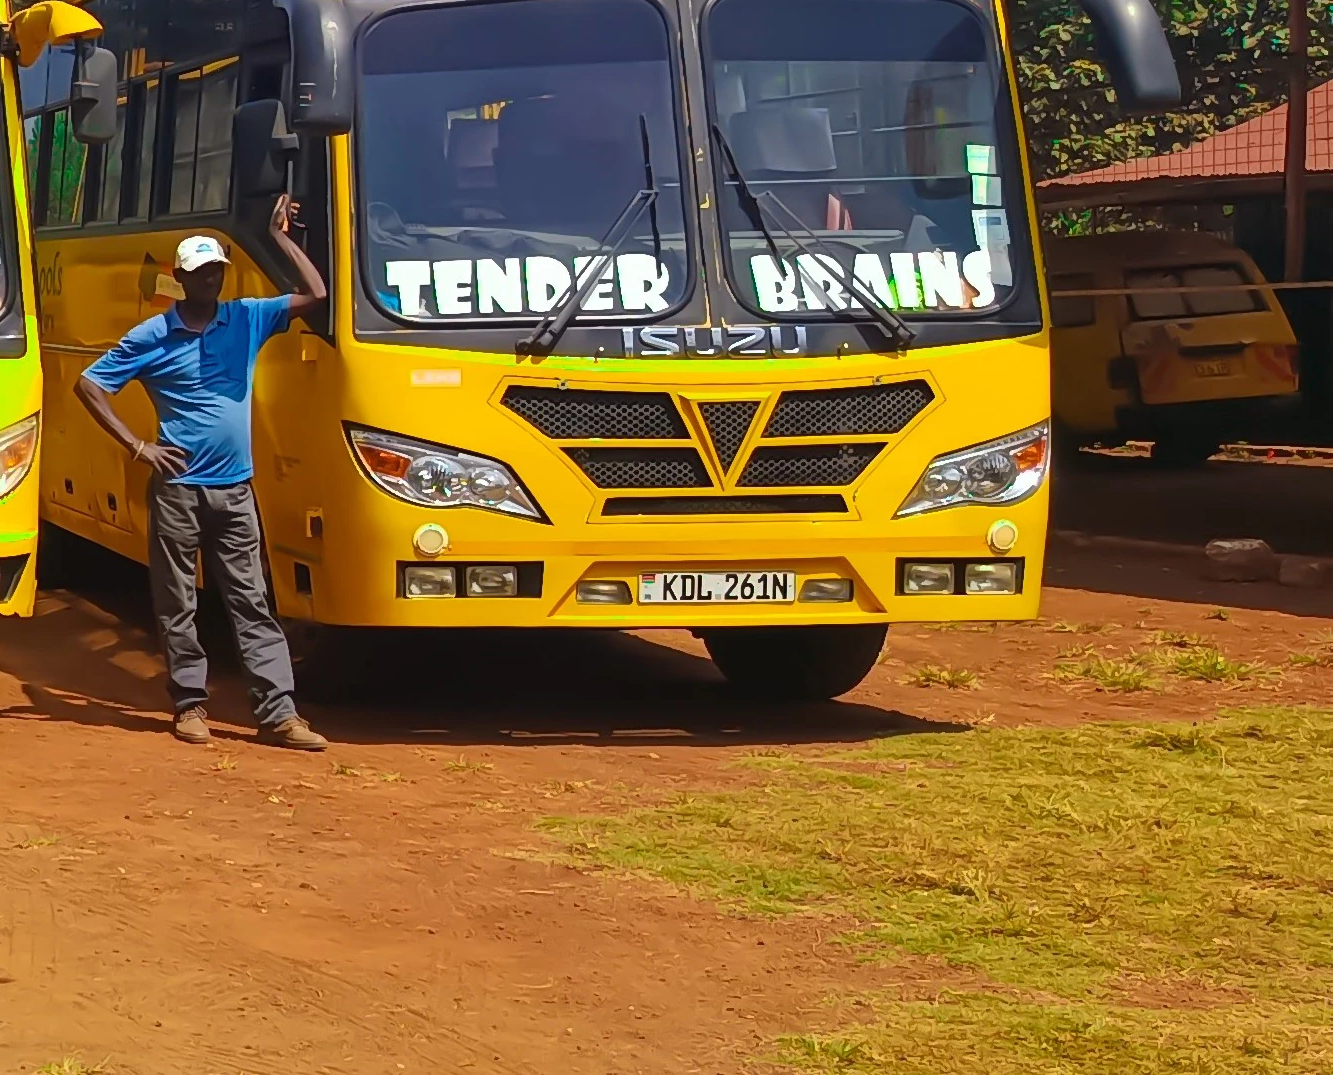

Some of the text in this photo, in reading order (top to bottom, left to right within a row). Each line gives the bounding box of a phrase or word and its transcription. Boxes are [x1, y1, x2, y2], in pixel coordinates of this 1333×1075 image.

[385, 250, 996, 316] TENDER BRAINS
[621, 326, 808, 358] ISUZU
[662, 574, 788, 601] KDL 261N
